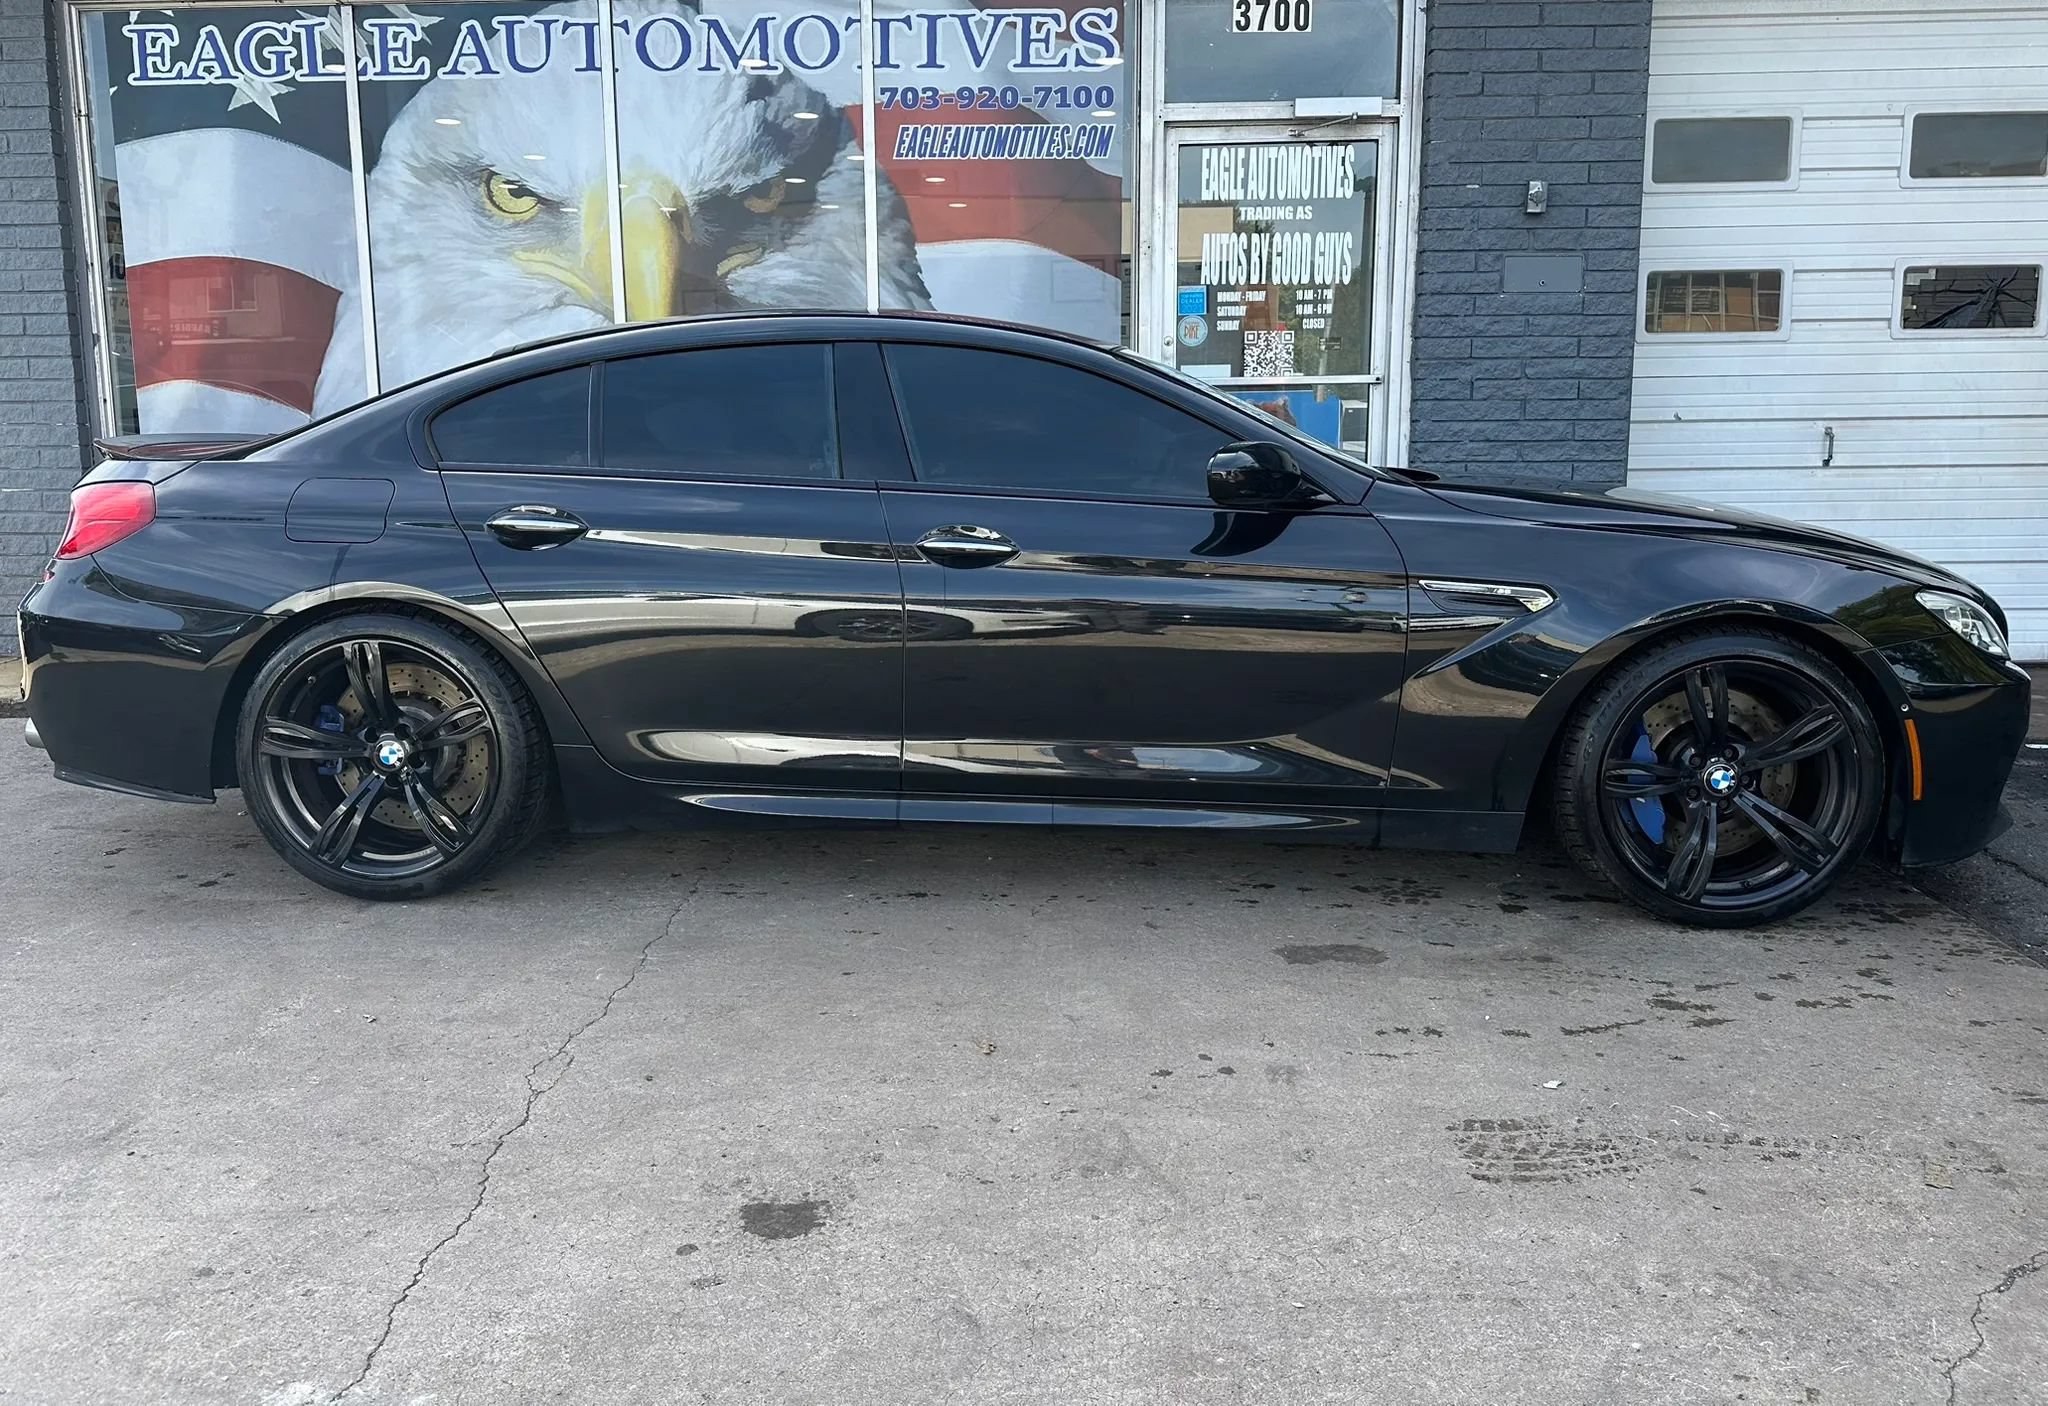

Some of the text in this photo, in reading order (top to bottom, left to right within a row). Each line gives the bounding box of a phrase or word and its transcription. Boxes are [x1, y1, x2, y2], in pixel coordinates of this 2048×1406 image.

[1235, 0, 1310, 32] 3700
[125, 10, 1118, 83] EAGLE AUTOMOTIVES
[879, 85, 1115, 109] 703-920-7100
[893, 124, 1115, 160] EAGLEAUTOMOTIVES.COM
[1201, 144, 1355, 202] EAGLE AUTOMOTIVES
[1239, 205, 1313, 221] TRADING AS
[1200, 231, 1353, 286] AUTOS BY GOOD GUYS
[1217, 291, 1242, 302] MONDAY
[1245, 290, 1266, 302] FRIDAY
[1296, 289, 1303, 300] 10
[1304, 289, 1314, 300] AM
[1323, 288, 1333, 300] PM
[1217, 305, 1247, 317] SATURDAY
[1296, 304, 1303, 315] 10
[1303, 304, 1313, 315] AM
[1323, 303, 1333, 315] PM
[1216, 320, 1240, 331] SUNDAY
[1302, 318, 1325, 329] CLOSED
